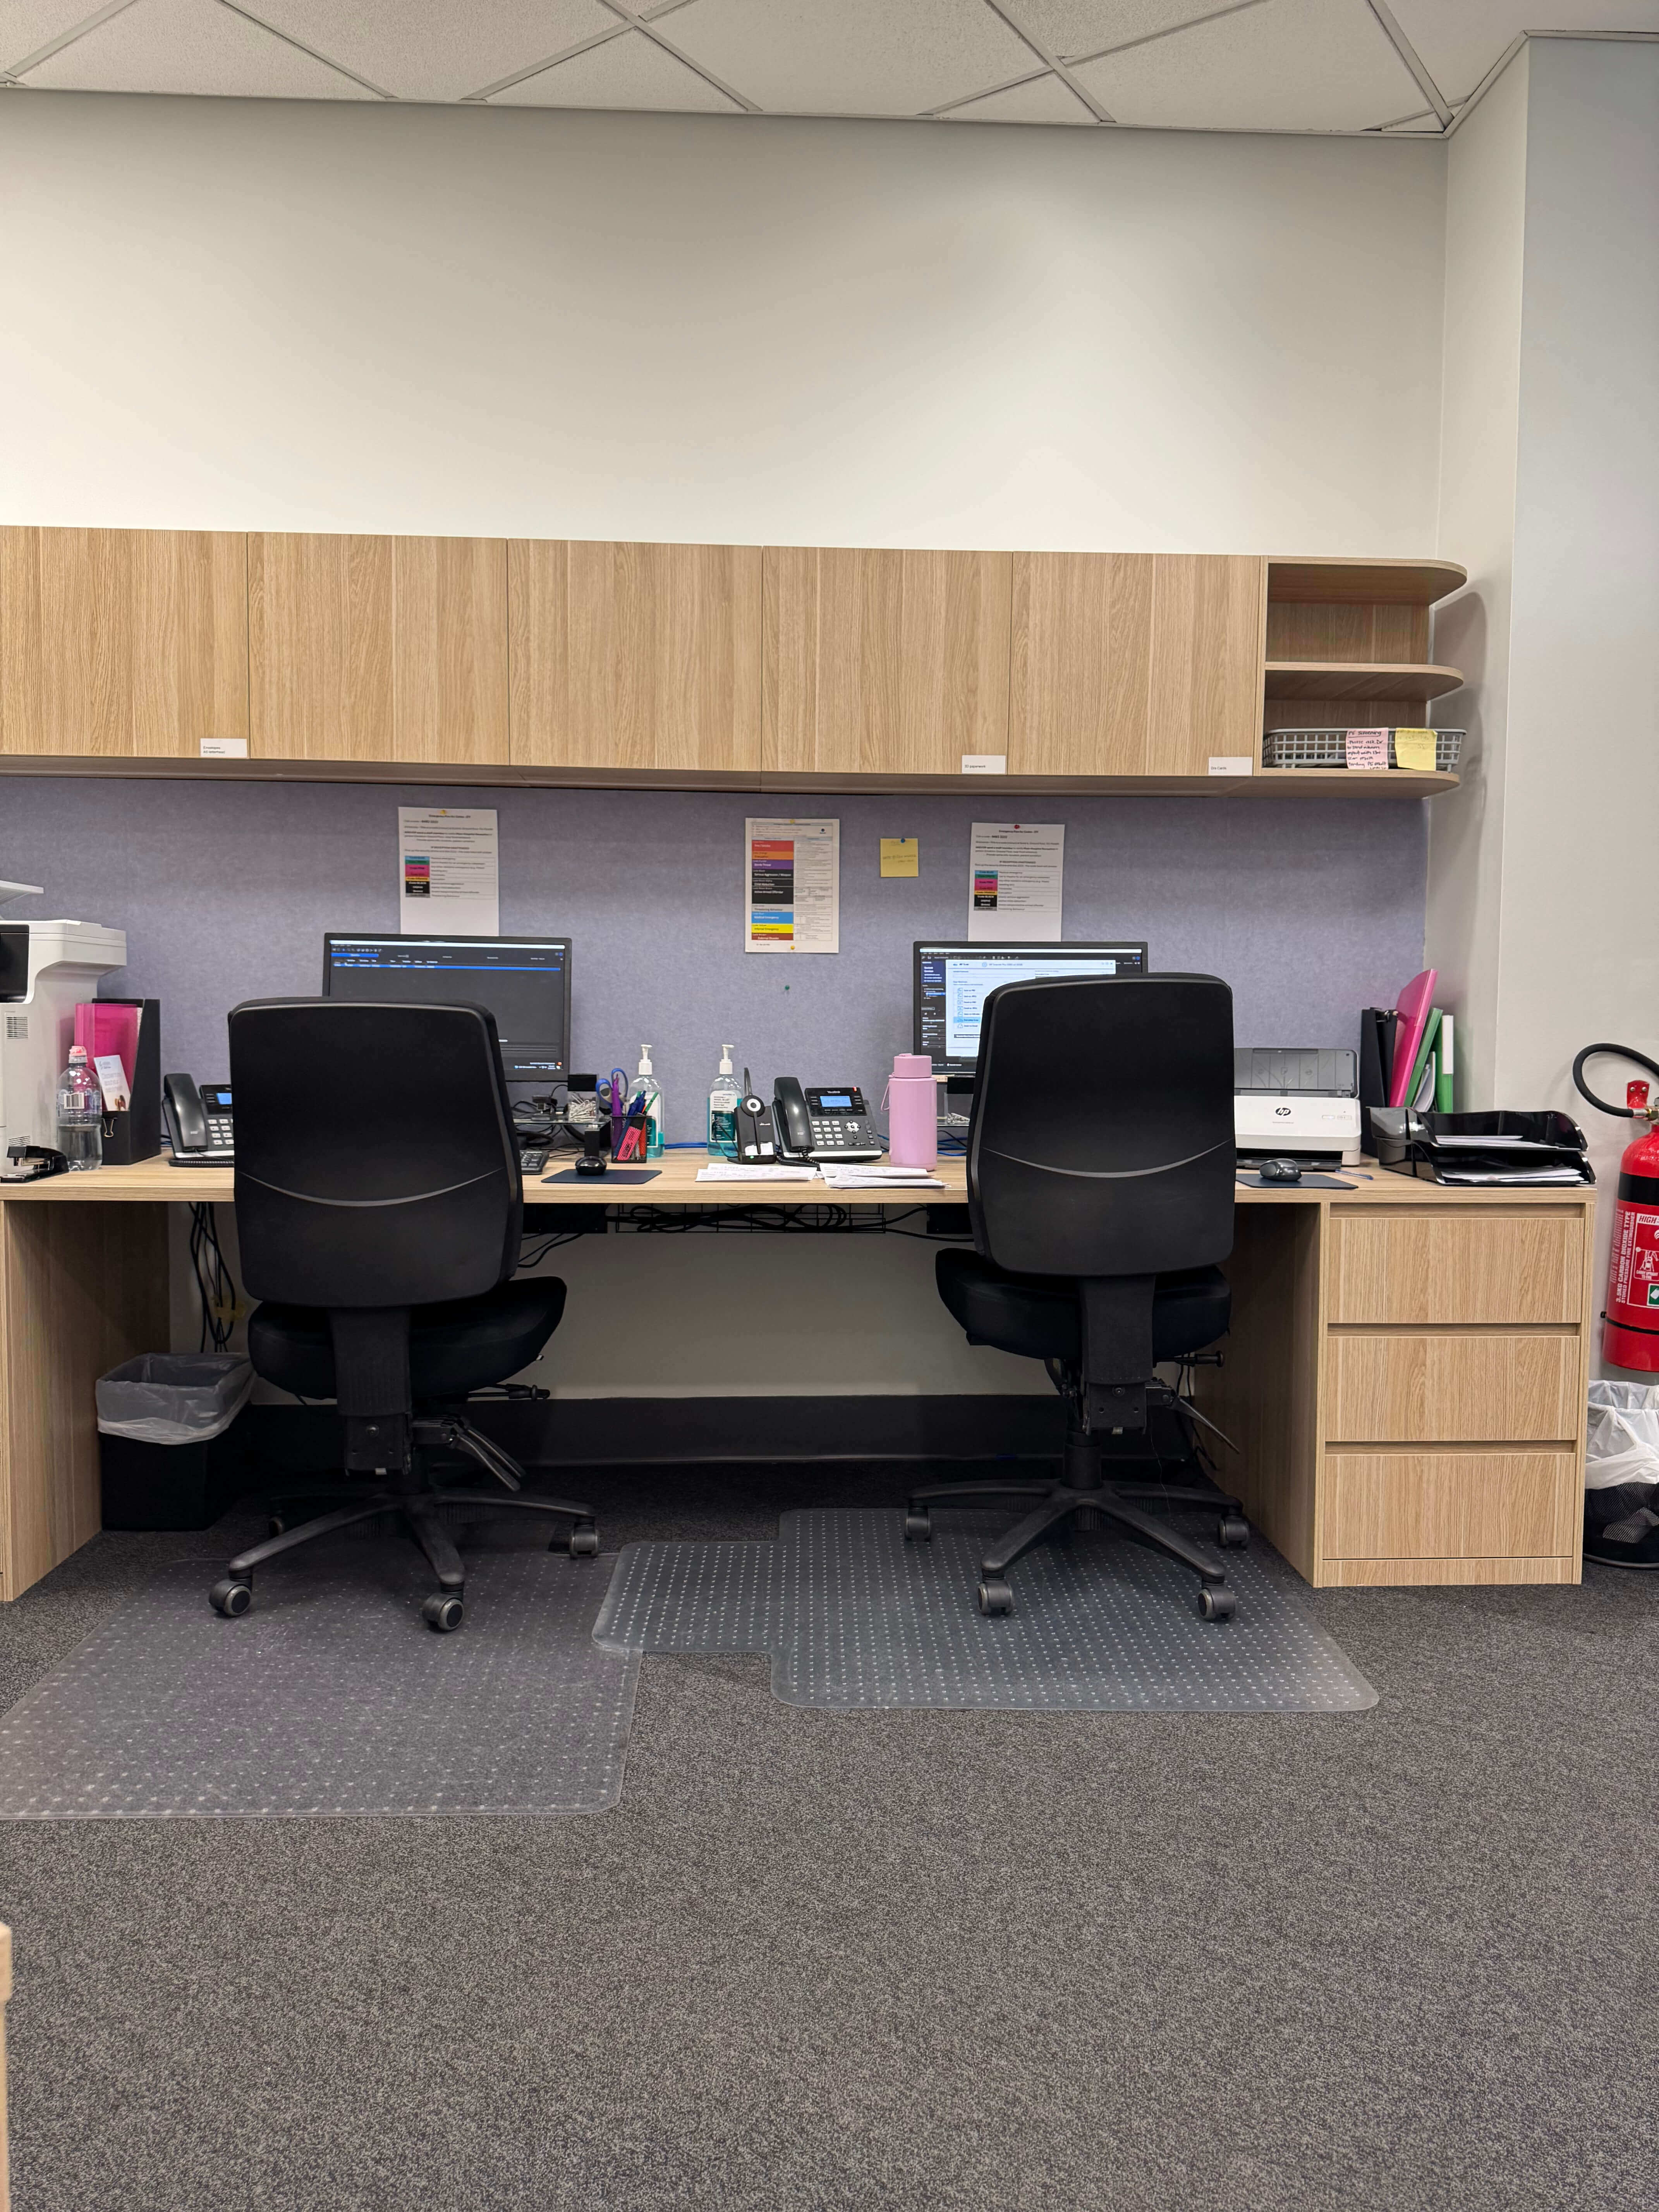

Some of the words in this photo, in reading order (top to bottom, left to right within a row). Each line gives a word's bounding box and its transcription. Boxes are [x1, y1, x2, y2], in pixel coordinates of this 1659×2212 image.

[1276, 1107, 1291, 1116] hp
[1638, 1215, 1657, 1224] HIGH
[1621, 1229, 1629, 1255] DIOXIDE
[1618, 1256, 1626, 1282] CARBON
